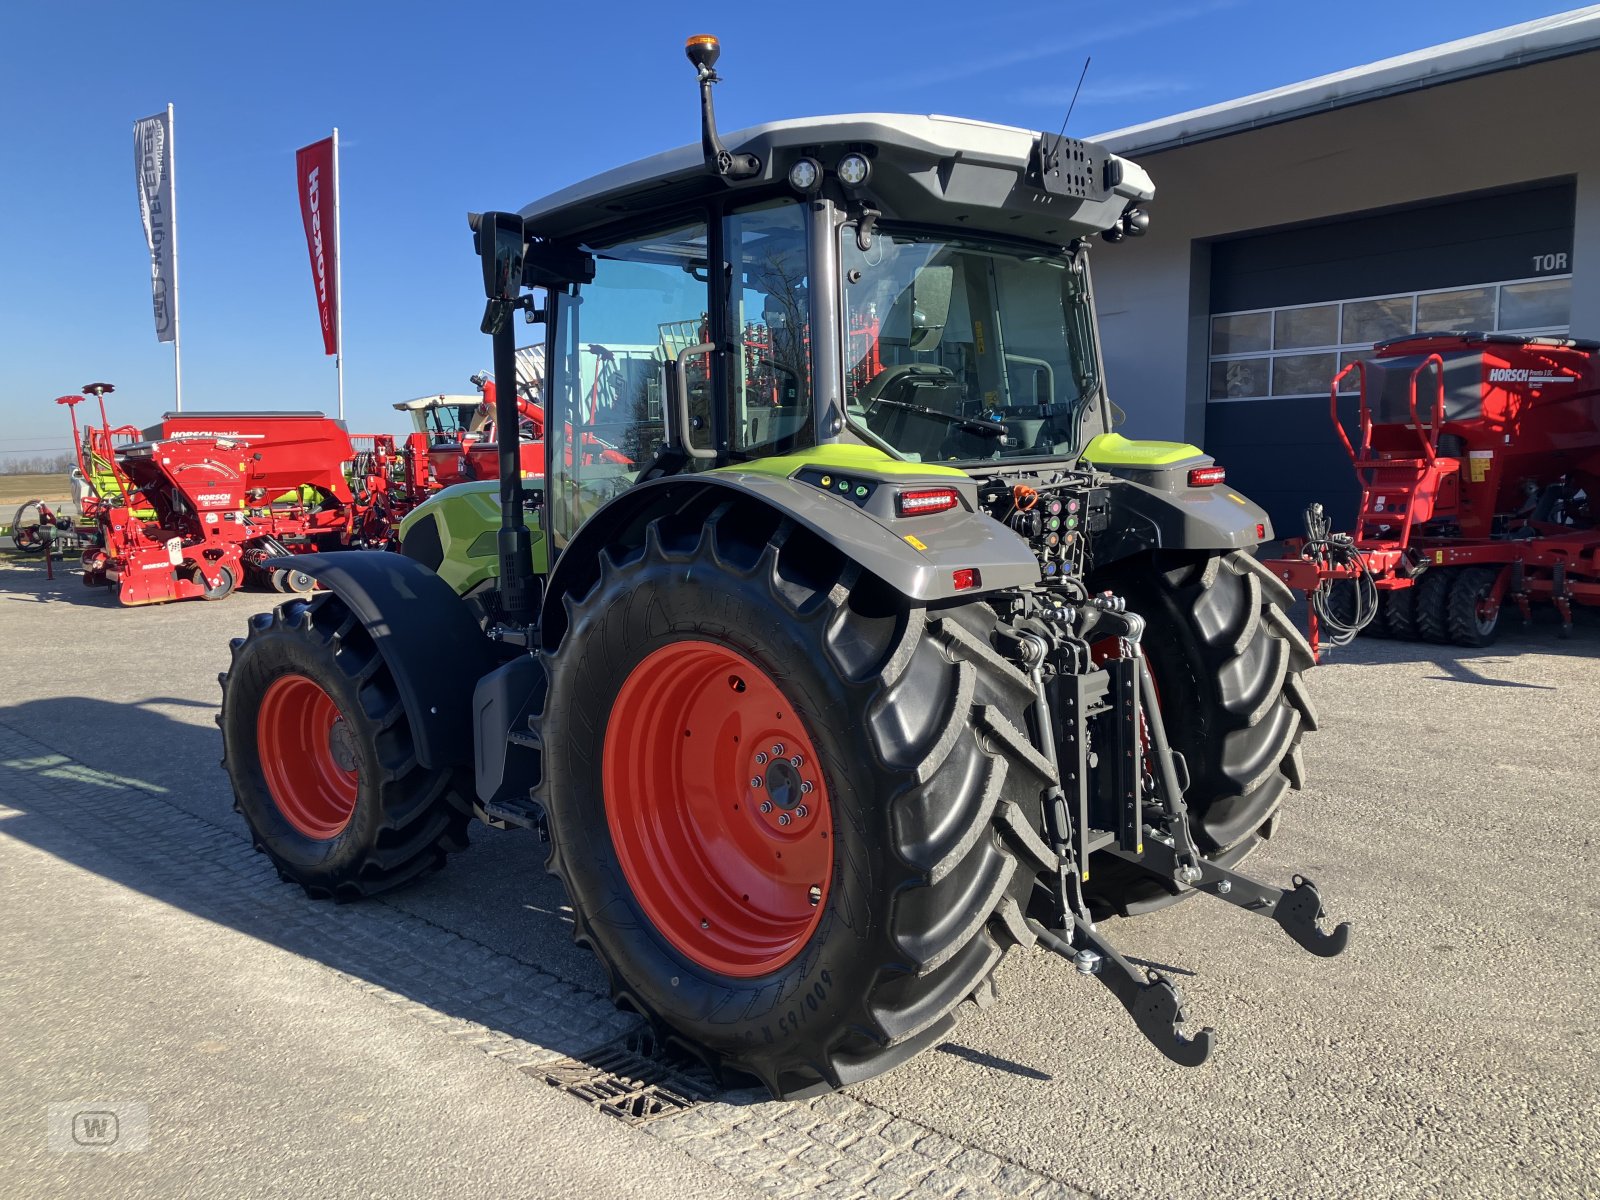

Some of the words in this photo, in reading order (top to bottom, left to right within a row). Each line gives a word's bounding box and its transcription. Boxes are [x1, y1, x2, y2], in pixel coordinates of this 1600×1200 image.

[1533, 253, 1567, 271] TOR
[1489, 368, 1529, 381] HORSCH
[197, 493, 231, 501] HORSCH
[142, 562, 169, 570] HORSCH
[779, 969, 833, 1037] 600/65
